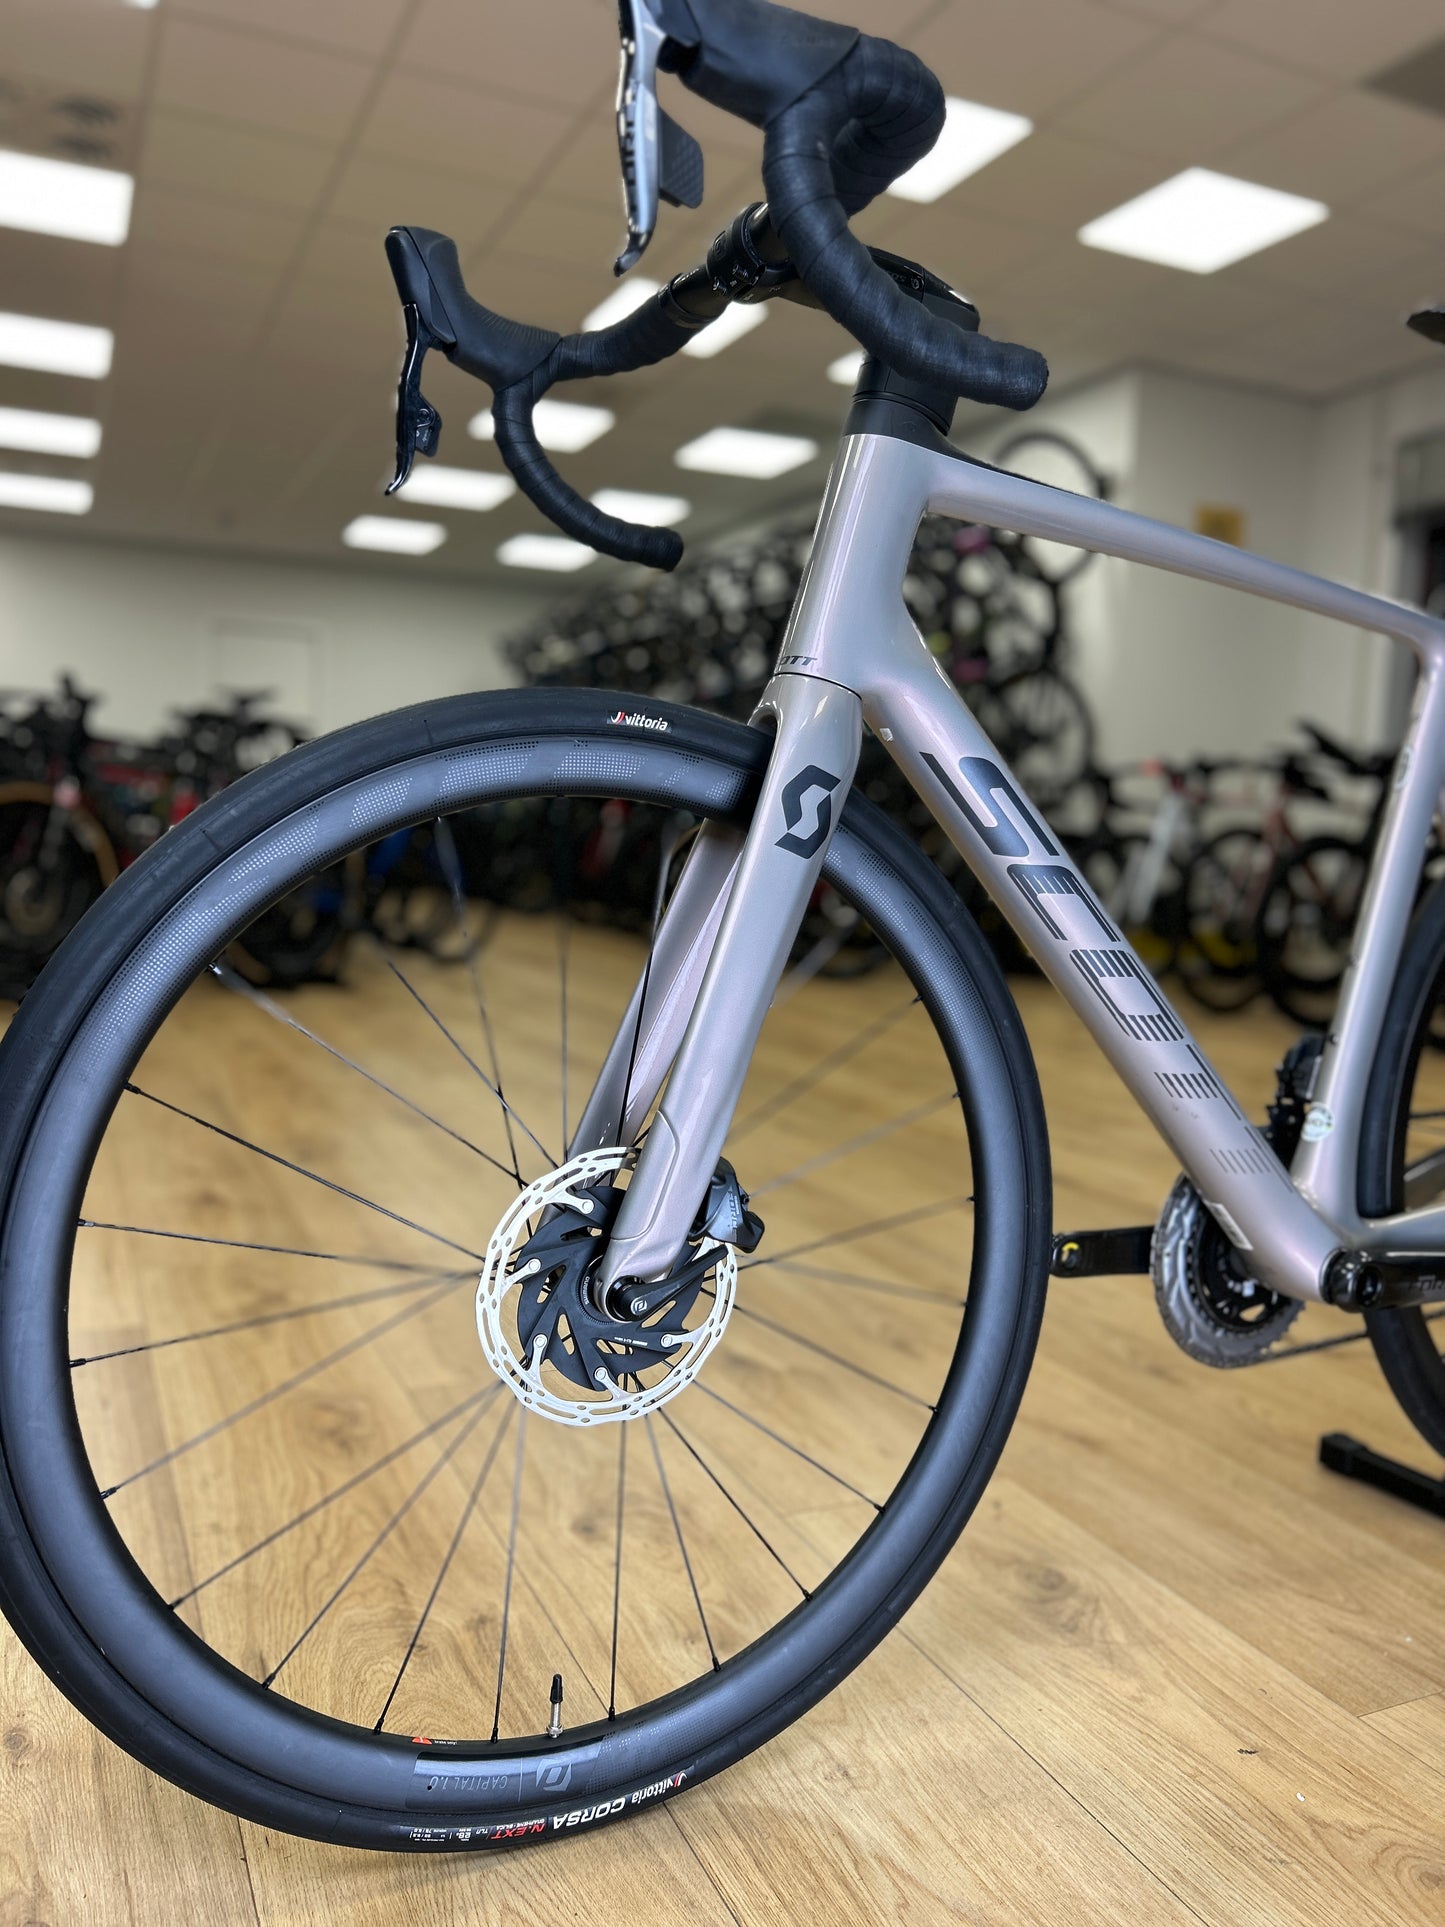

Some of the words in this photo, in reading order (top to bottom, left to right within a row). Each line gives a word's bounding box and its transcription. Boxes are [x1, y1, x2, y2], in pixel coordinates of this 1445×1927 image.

[625, 713, 669, 731] vittoria
[454, 1775, 508, 1791] CAPITAL
[631, 1777, 673, 1804] vittoria
[553, 1797, 626, 1830] CORSA
